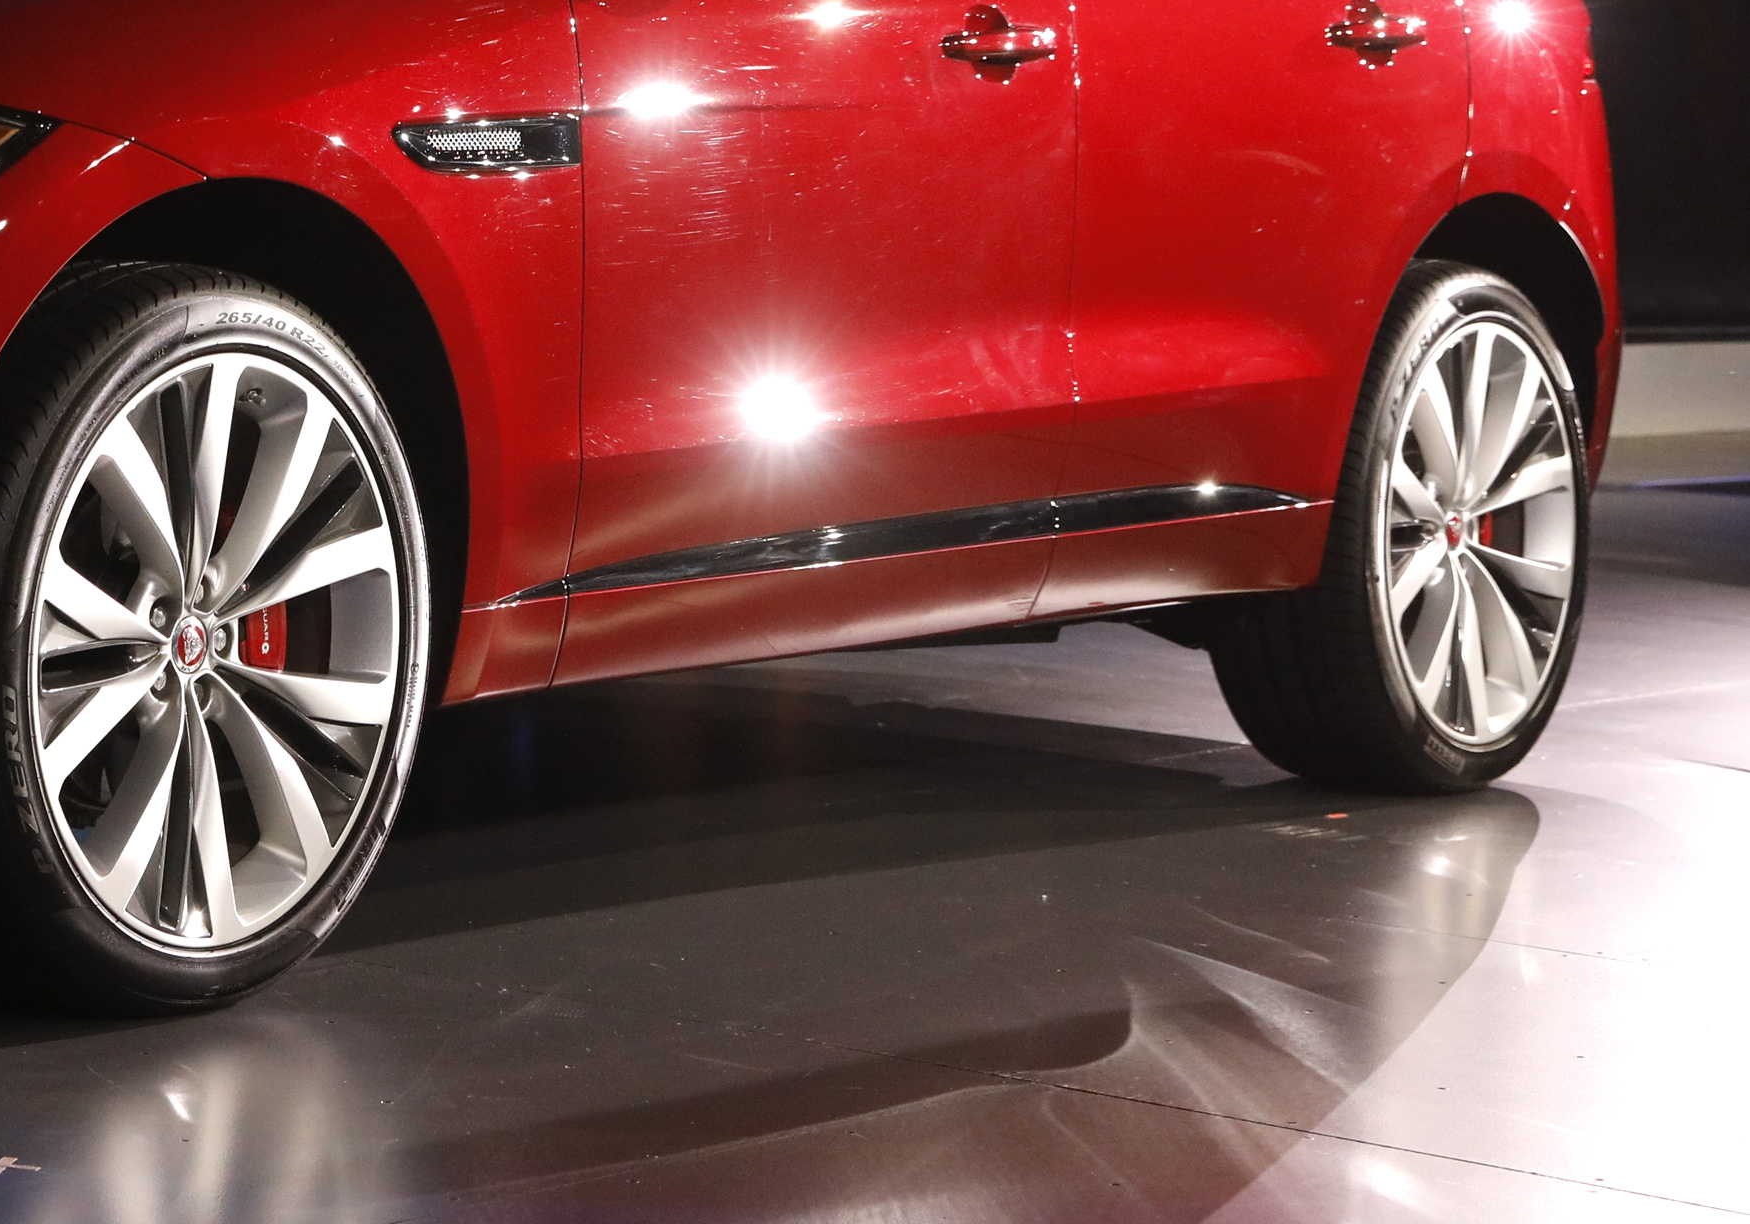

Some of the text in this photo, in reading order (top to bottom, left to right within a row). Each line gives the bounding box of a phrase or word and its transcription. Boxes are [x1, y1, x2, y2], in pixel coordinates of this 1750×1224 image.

[216, 312, 286, 331] 265/40
[2, 684, 56, 874] P ZERO
